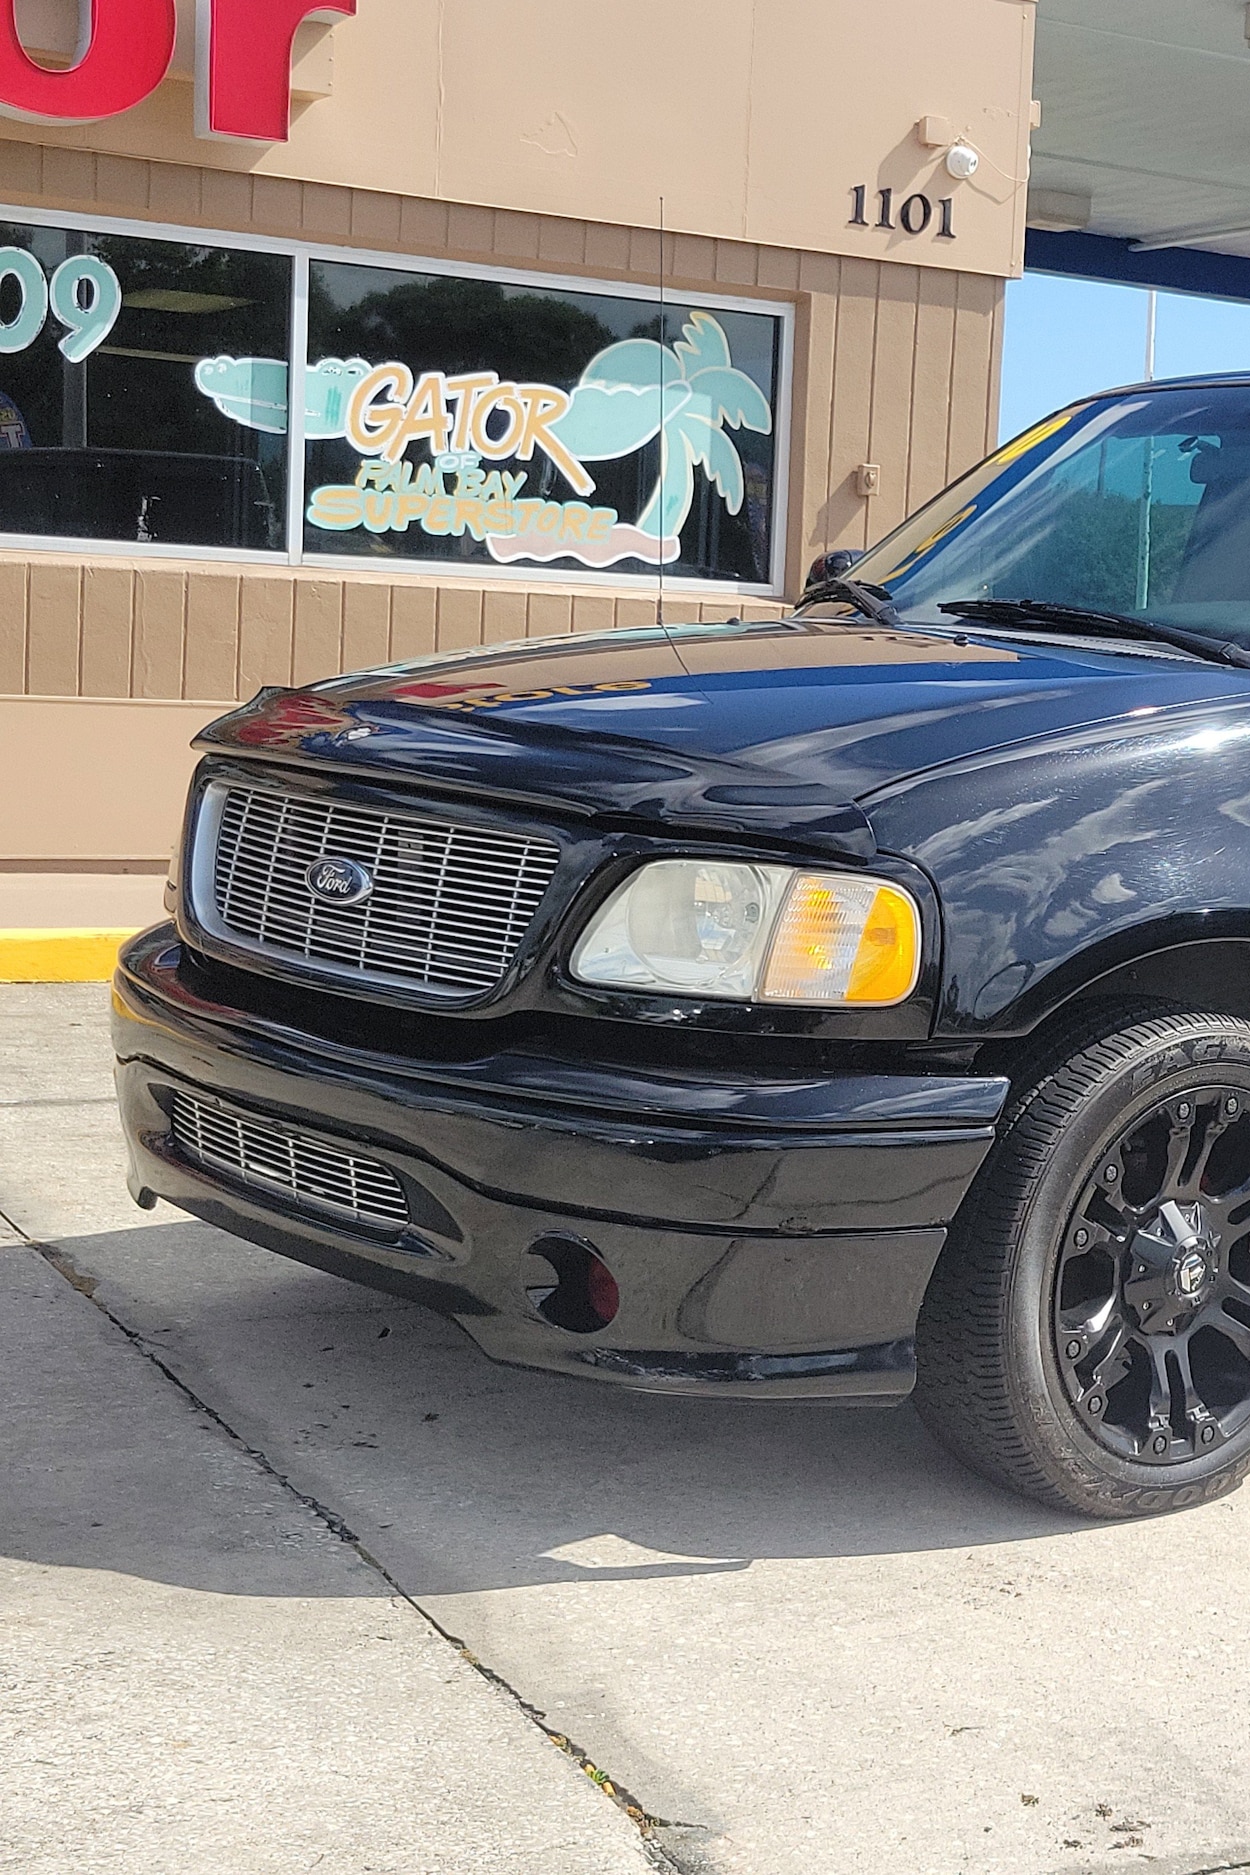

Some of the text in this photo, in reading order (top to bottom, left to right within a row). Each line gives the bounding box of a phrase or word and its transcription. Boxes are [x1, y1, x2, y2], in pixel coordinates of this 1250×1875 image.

[848, 185, 956, 239] 1101
[346, 361, 597, 497] GATOR
[356, 458, 528, 503] PALM BAY
[435, 450, 482, 473] OF
[307, 485, 618, 543] SUPERSTORE
[316, 864, 353, 894] Ford
